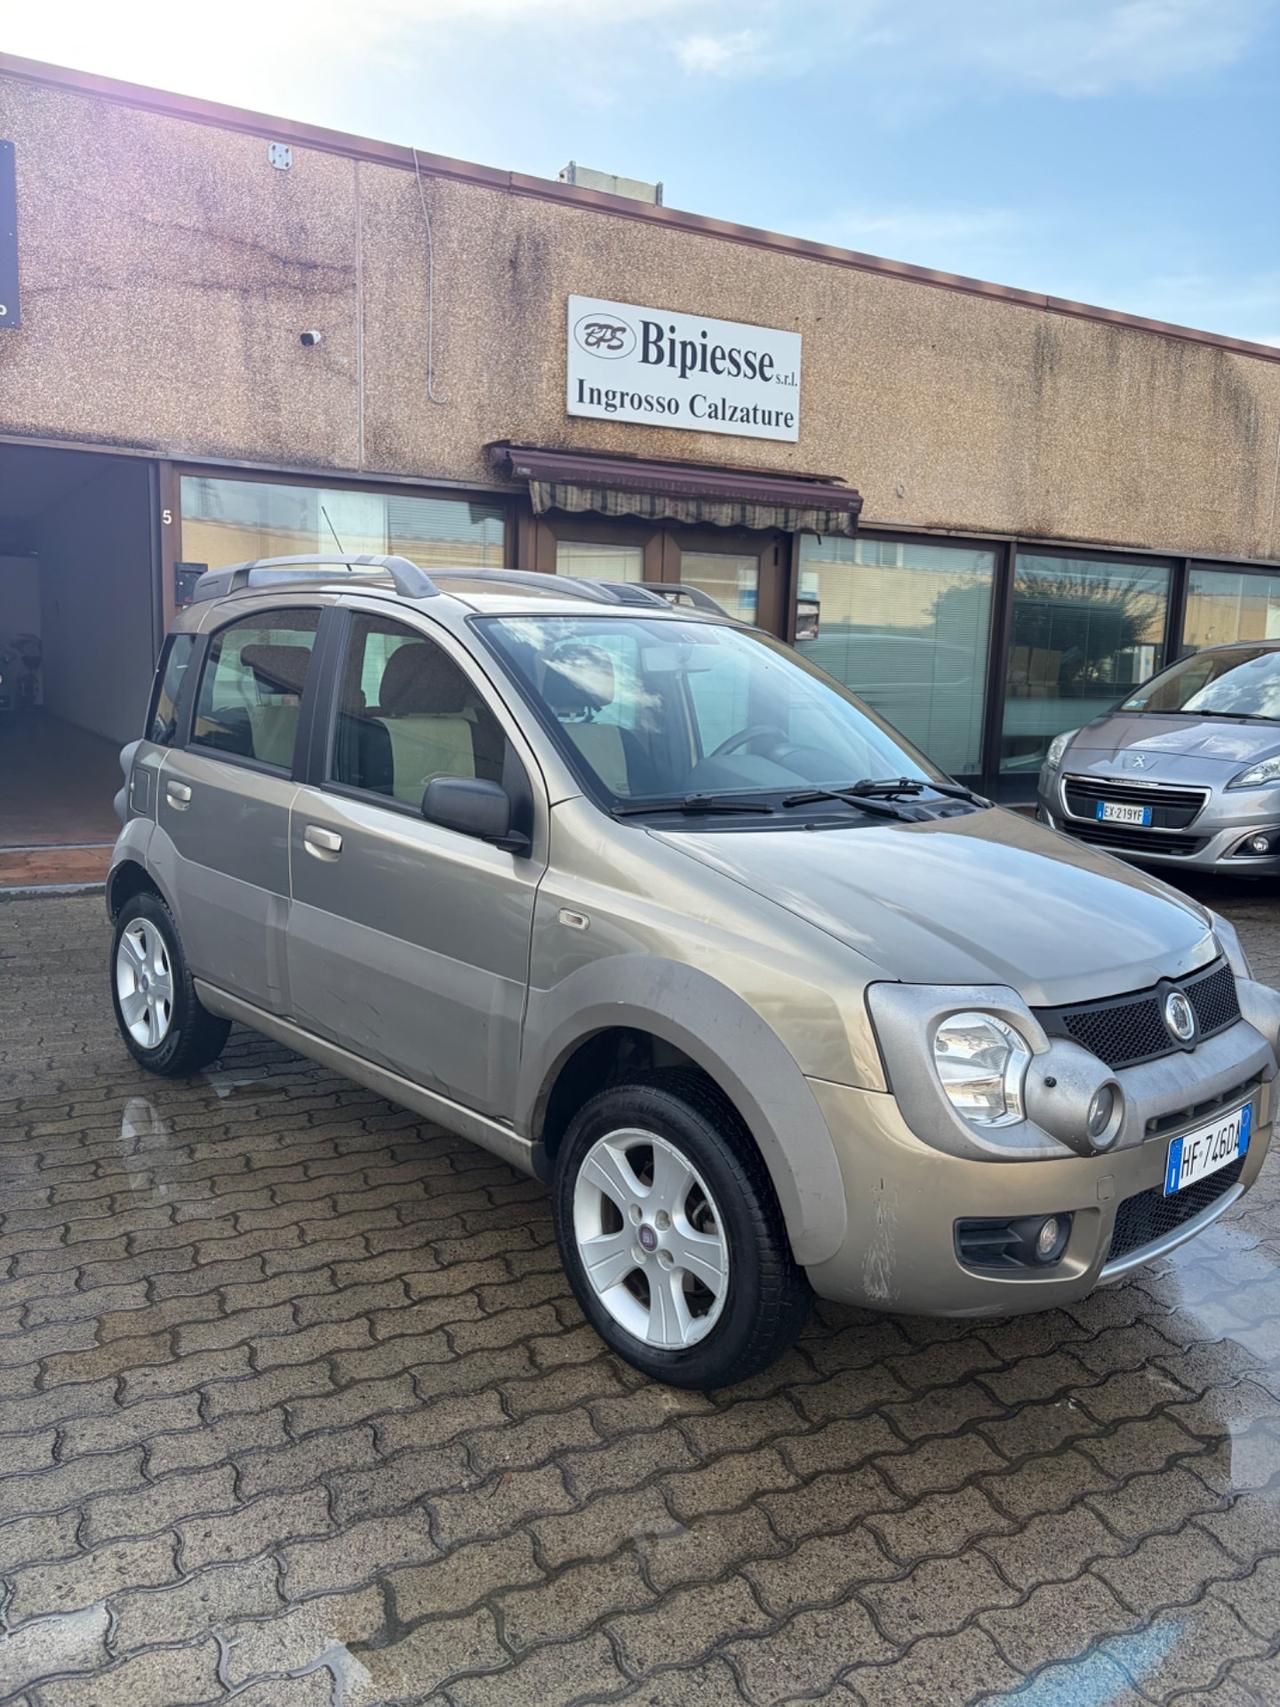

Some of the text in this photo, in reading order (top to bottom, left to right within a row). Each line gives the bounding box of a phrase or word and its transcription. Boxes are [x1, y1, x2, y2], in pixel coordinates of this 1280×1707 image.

[638, 320, 798, 387] Bipiesse s.r.l.
[576, 378, 795, 428] Ingrosso Calzature
[162, 509, 172, 525] 5
